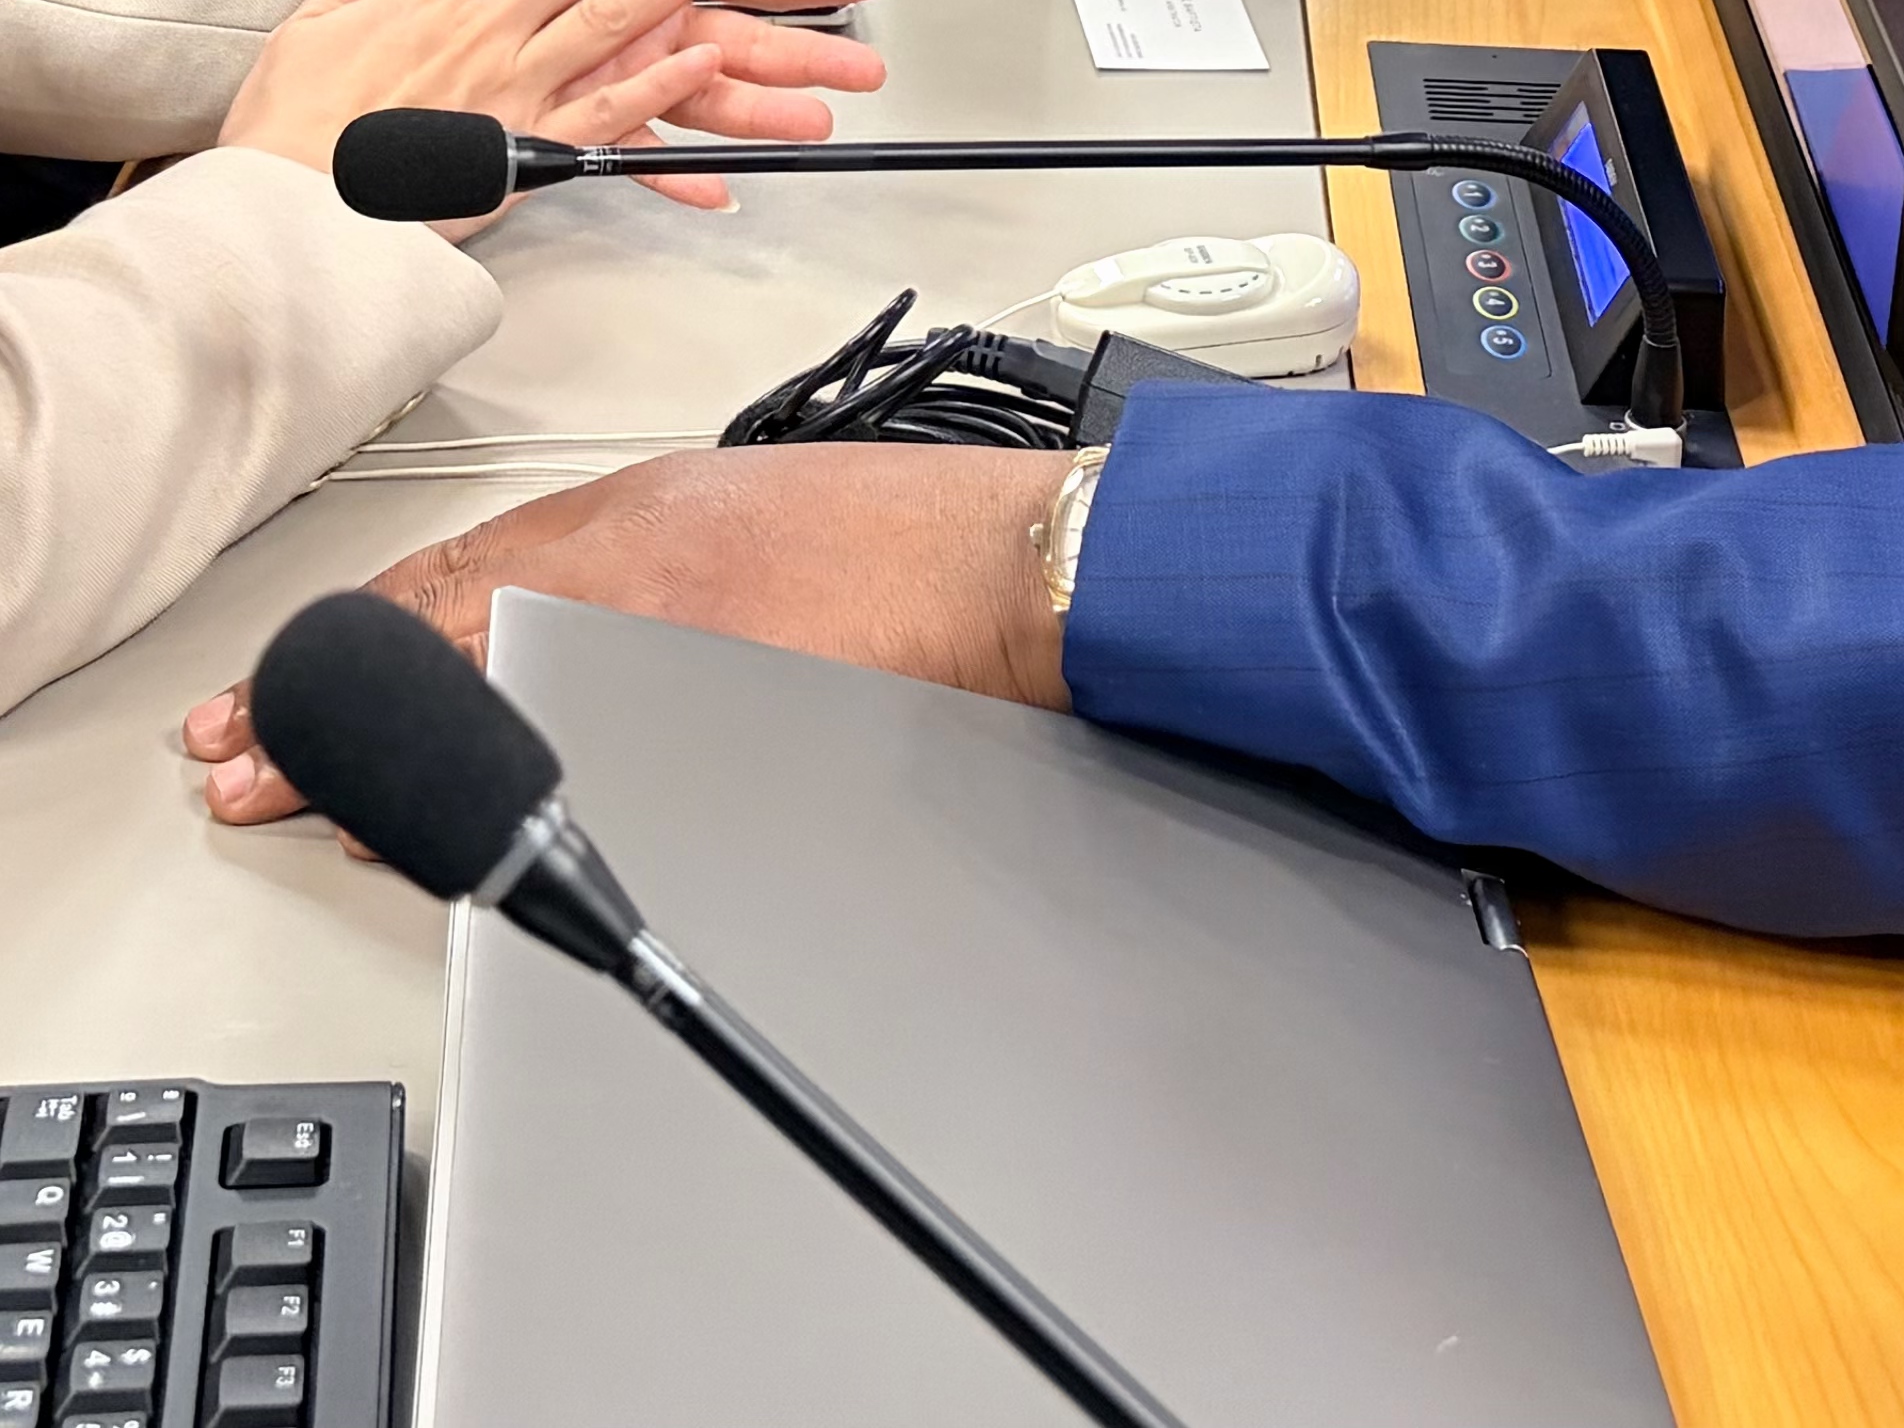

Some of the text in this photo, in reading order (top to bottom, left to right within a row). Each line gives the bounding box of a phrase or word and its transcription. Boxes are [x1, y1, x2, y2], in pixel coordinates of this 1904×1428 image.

[295, 1122, 314, 1149] Esc
[112, 1151, 138, 1163] 1
[35, 1185, 65, 1206] Q
[102, 1214, 129, 1230] 2
[287, 1229, 305, 1247] F1
[25, 1248, 54, 1273] W
[94, 1280, 121, 1298] 3
[281, 1296, 301, 1317] F2
[14, 1322, 45, 1337] E
[84, 1354, 111, 1368] 4
[121, 1349, 152, 1366] $
[275, 1366, 296, 1389] F3
[2, 1389, 34, 1412] R
